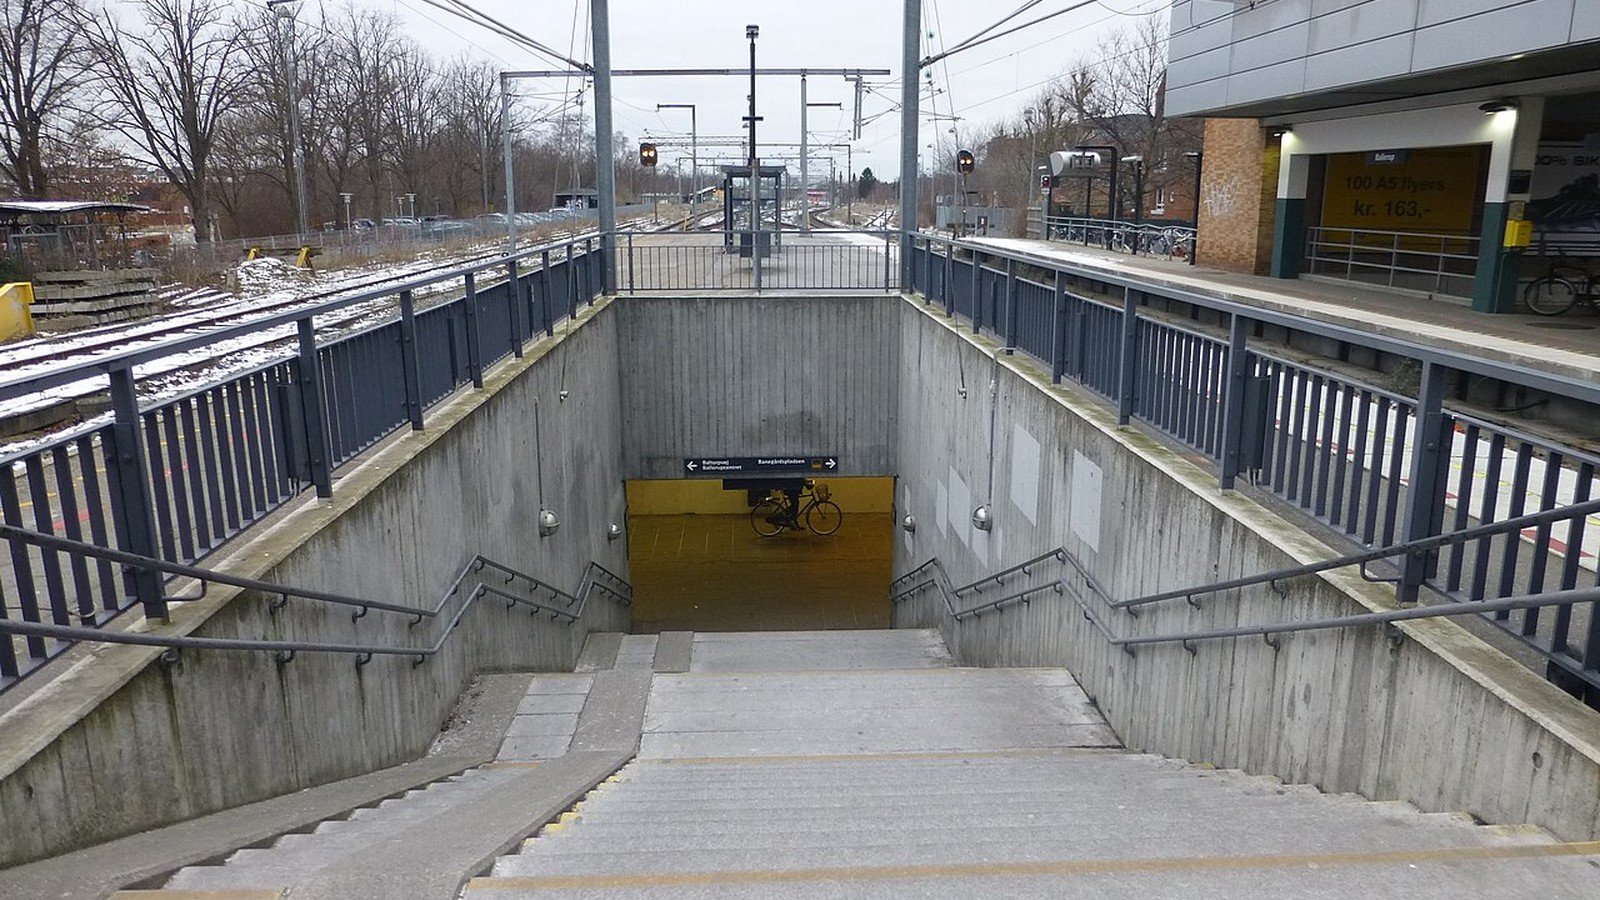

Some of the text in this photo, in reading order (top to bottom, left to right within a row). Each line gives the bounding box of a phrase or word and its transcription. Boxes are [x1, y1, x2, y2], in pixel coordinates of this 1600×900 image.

[1346, 175, 1445, 193] 100 A5 flyers
[1354, 200, 1431, 219] kr. 163,-
